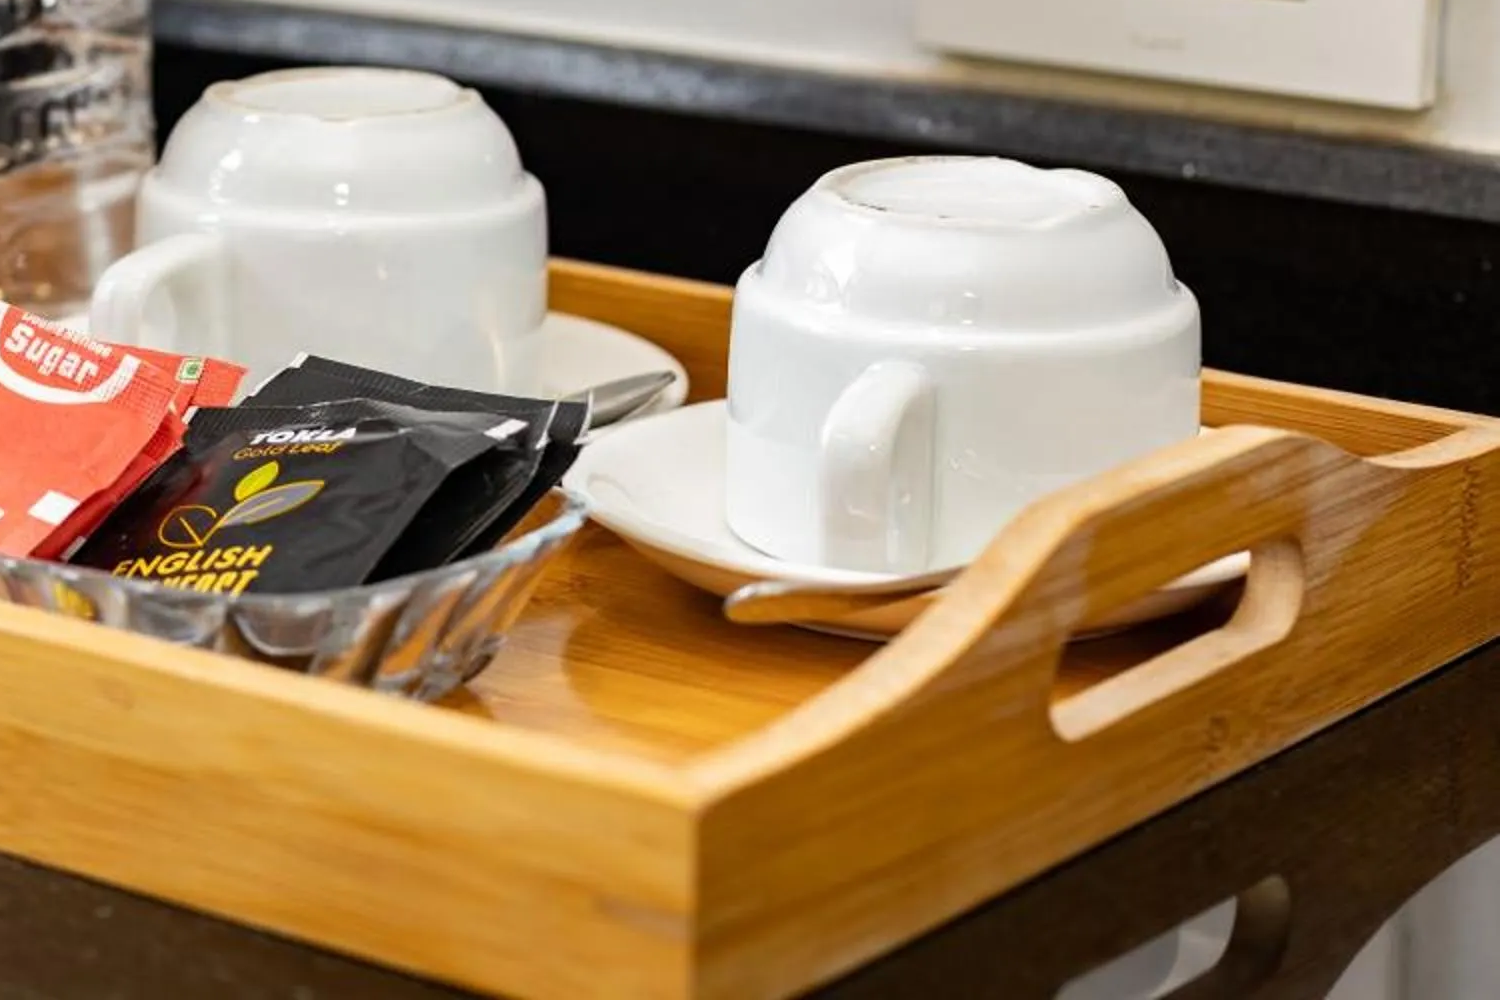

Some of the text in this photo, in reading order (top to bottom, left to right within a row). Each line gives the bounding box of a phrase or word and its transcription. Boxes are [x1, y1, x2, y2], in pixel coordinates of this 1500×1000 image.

[3, 322, 100, 385] Sugar
[233, 444, 288, 461] Gold
[111, 545, 274, 579] ENGLISH
